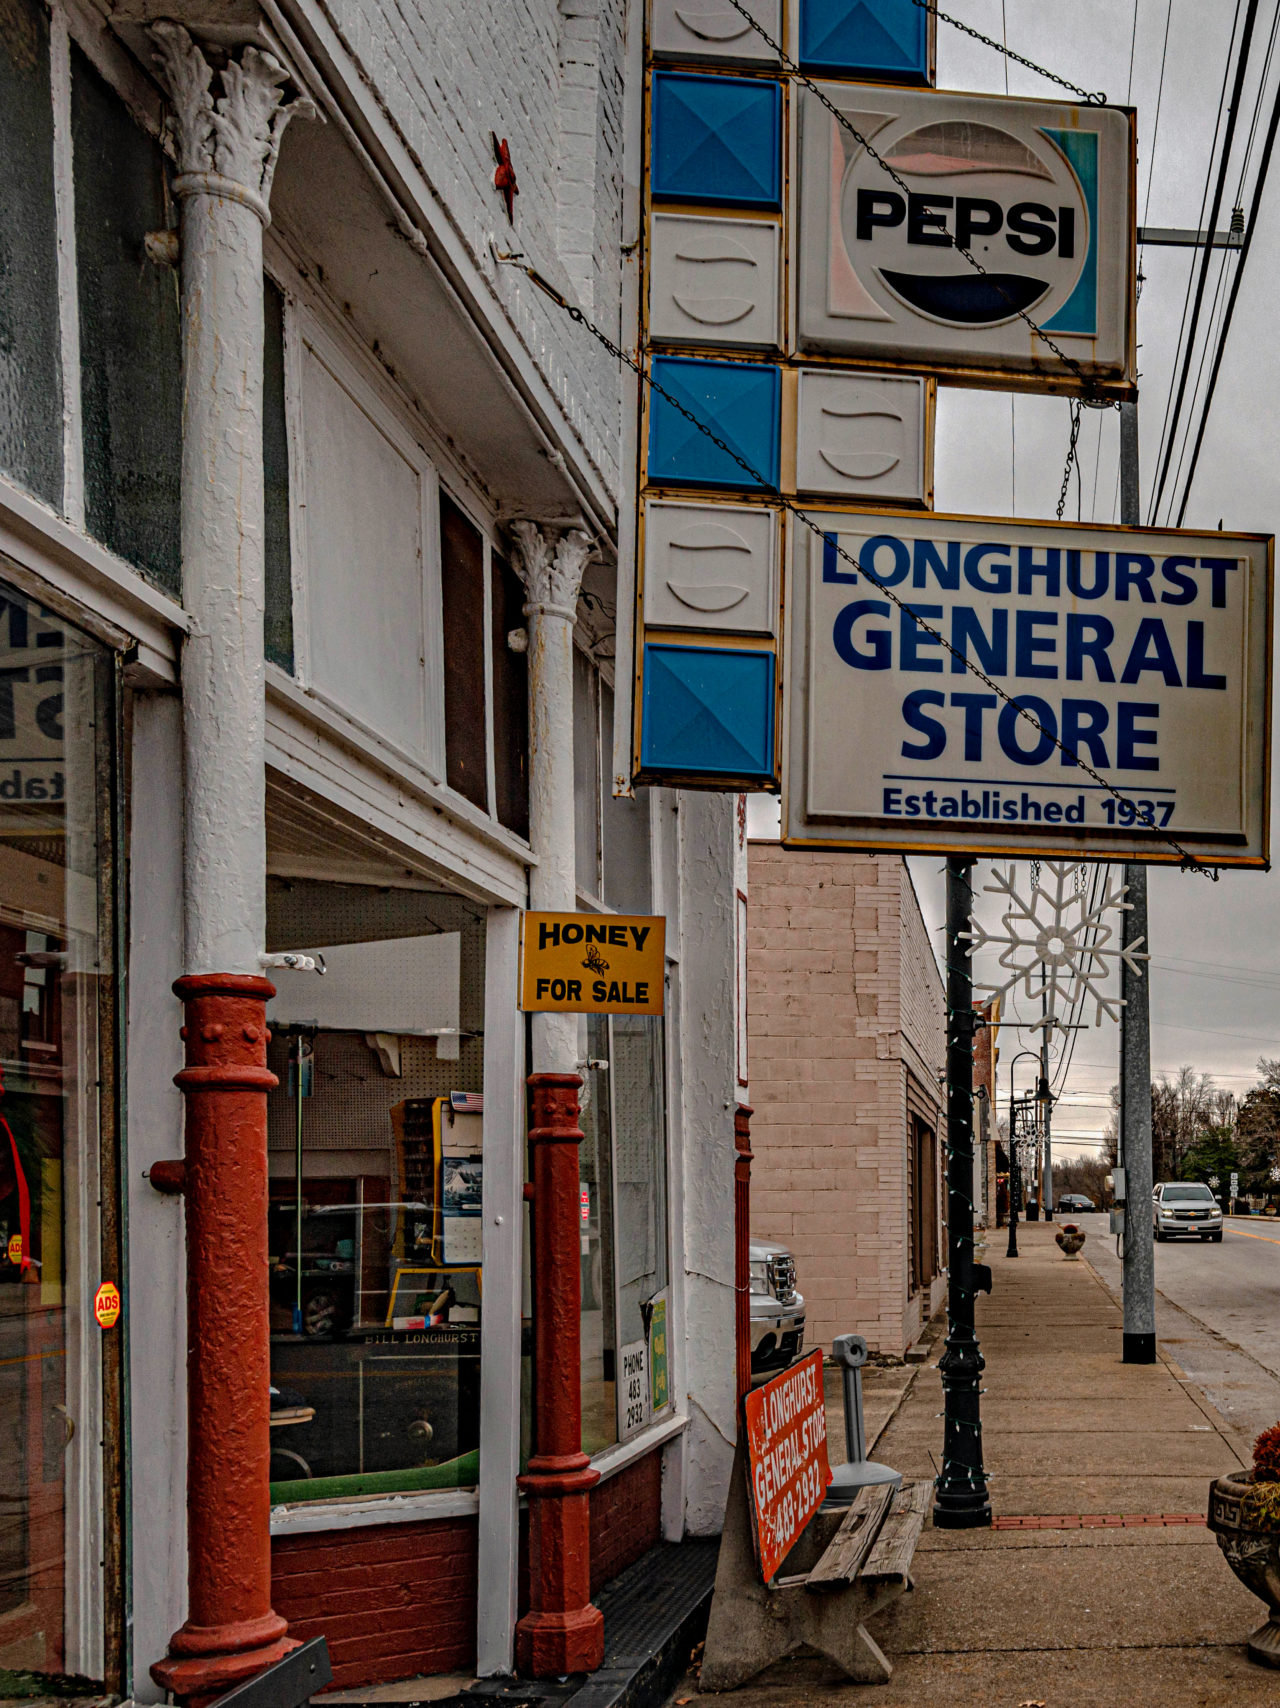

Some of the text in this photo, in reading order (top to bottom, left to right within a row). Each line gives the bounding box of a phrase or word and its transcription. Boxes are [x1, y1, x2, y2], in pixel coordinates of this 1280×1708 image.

[856, 188, 1075, 259] PEPSI
[822, 531, 1238, 608] LONGHURST
[833, 600, 1227, 690] GENERAL
[901, 689, 1160, 771] STORE
[882, 787, 1176, 828] Established 1937
[538, 922, 651, 952] HONEY
[536, 978, 649, 1004] FOR SALE
[97, 1295, 118, 1312] ADS
[365, 1333, 479, 1344] BILL LONGHURST
[624, 1351, 644, 1378] PHONE
[628, 1379, 641, 1400] 483
[763, 1363, 818, 1440] LONGHURST
[627, 1402, 643, 1429] 2932
[755, 1404, 826, 1510] GENERAL STORE
